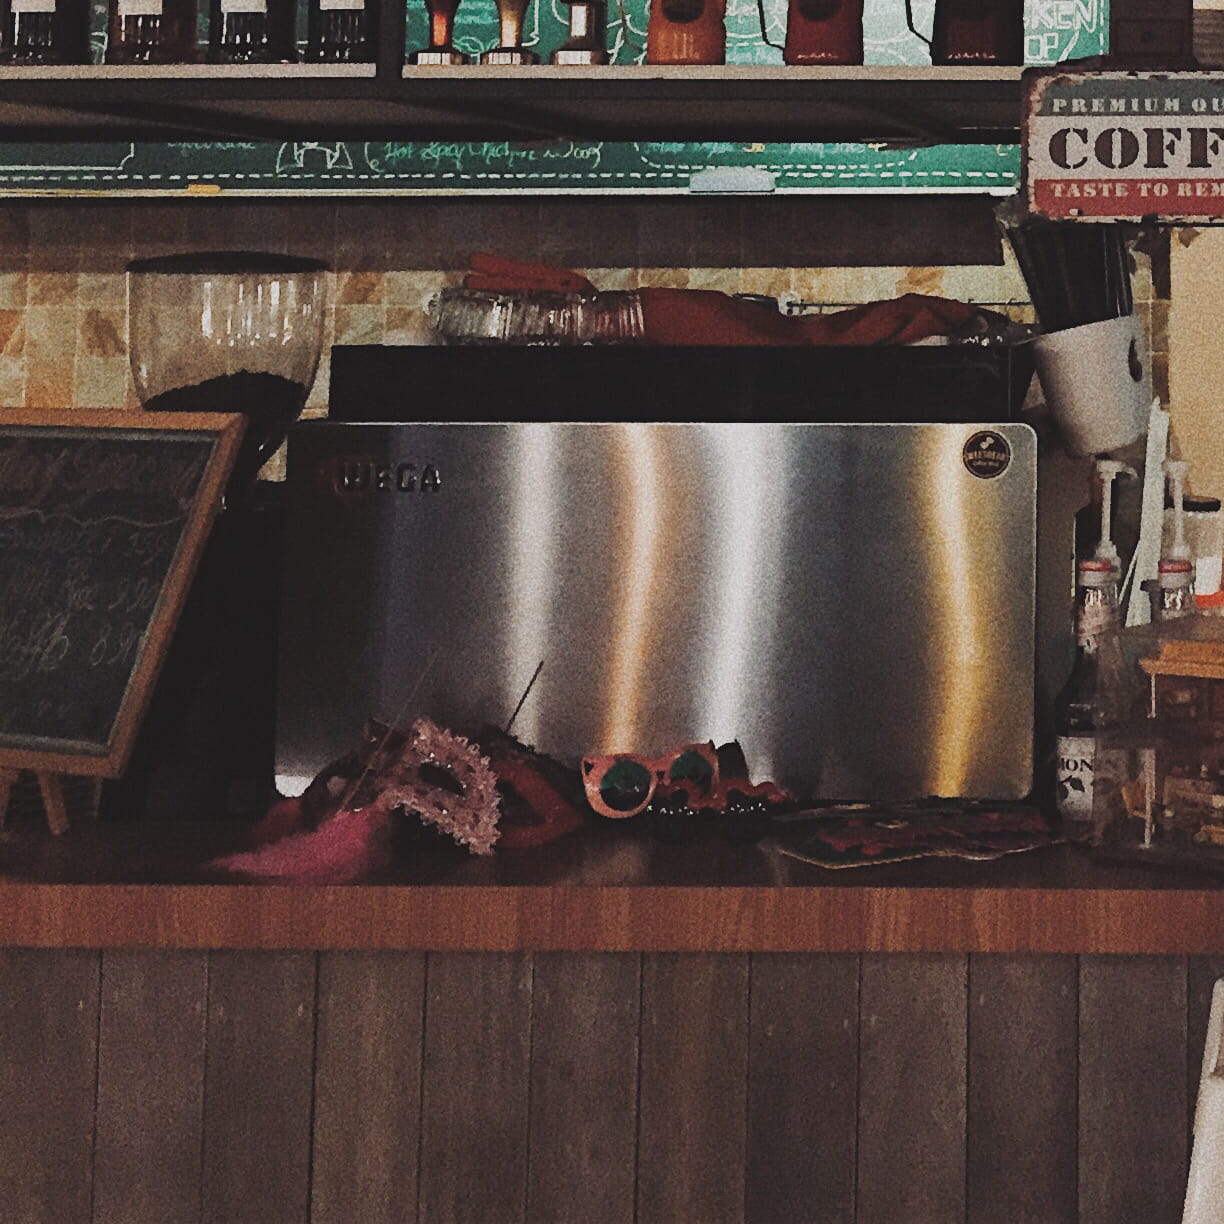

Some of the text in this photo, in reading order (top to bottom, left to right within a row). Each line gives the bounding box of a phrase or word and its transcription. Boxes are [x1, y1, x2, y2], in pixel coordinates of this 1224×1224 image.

[1051, 97, 1181, 113] PREMIUM
[1052, 183, 1129, 198] TASTE
[1137, 183, 1169, 197] TO
